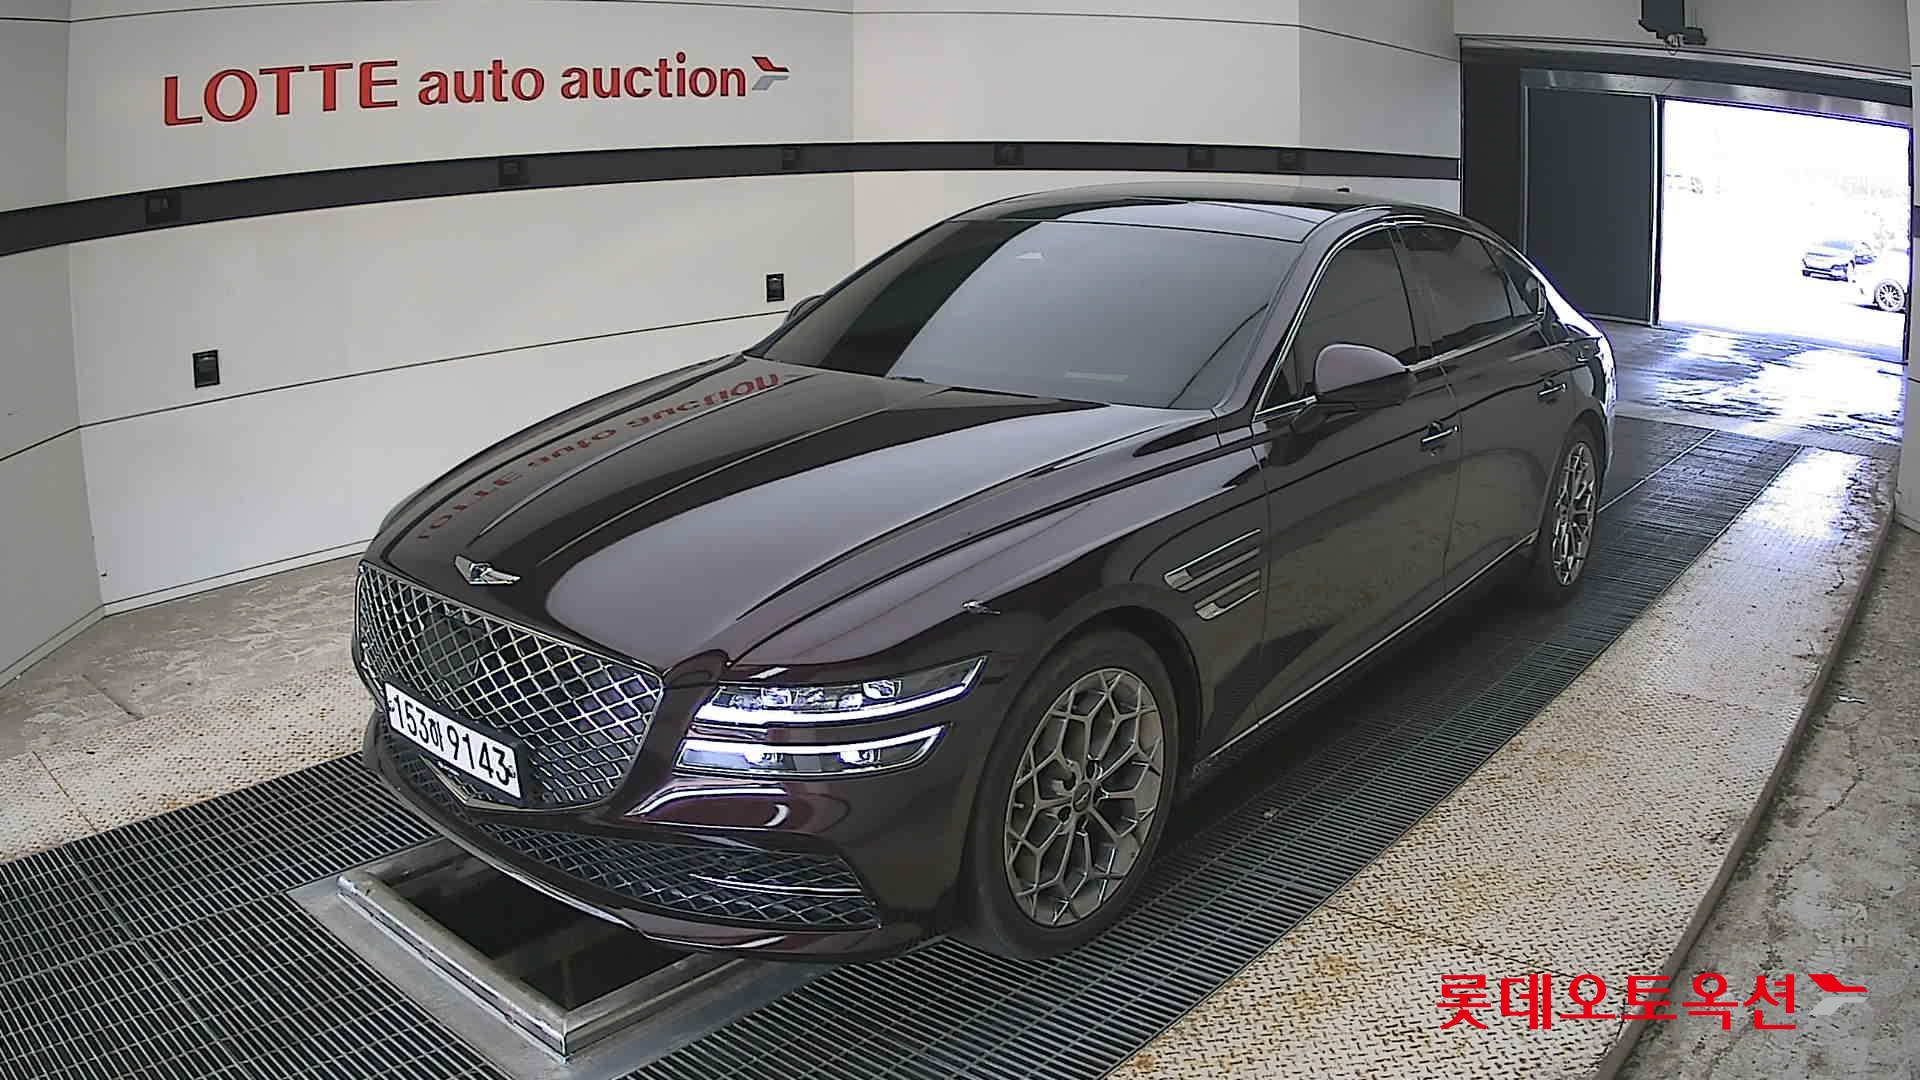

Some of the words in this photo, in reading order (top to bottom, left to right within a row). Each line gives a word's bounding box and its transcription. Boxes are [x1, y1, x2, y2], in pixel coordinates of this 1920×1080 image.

[163, 60, 398, 126] LOTTE
[417, 58, 545, 105] auto
[560, 51, 747, 98] auction
